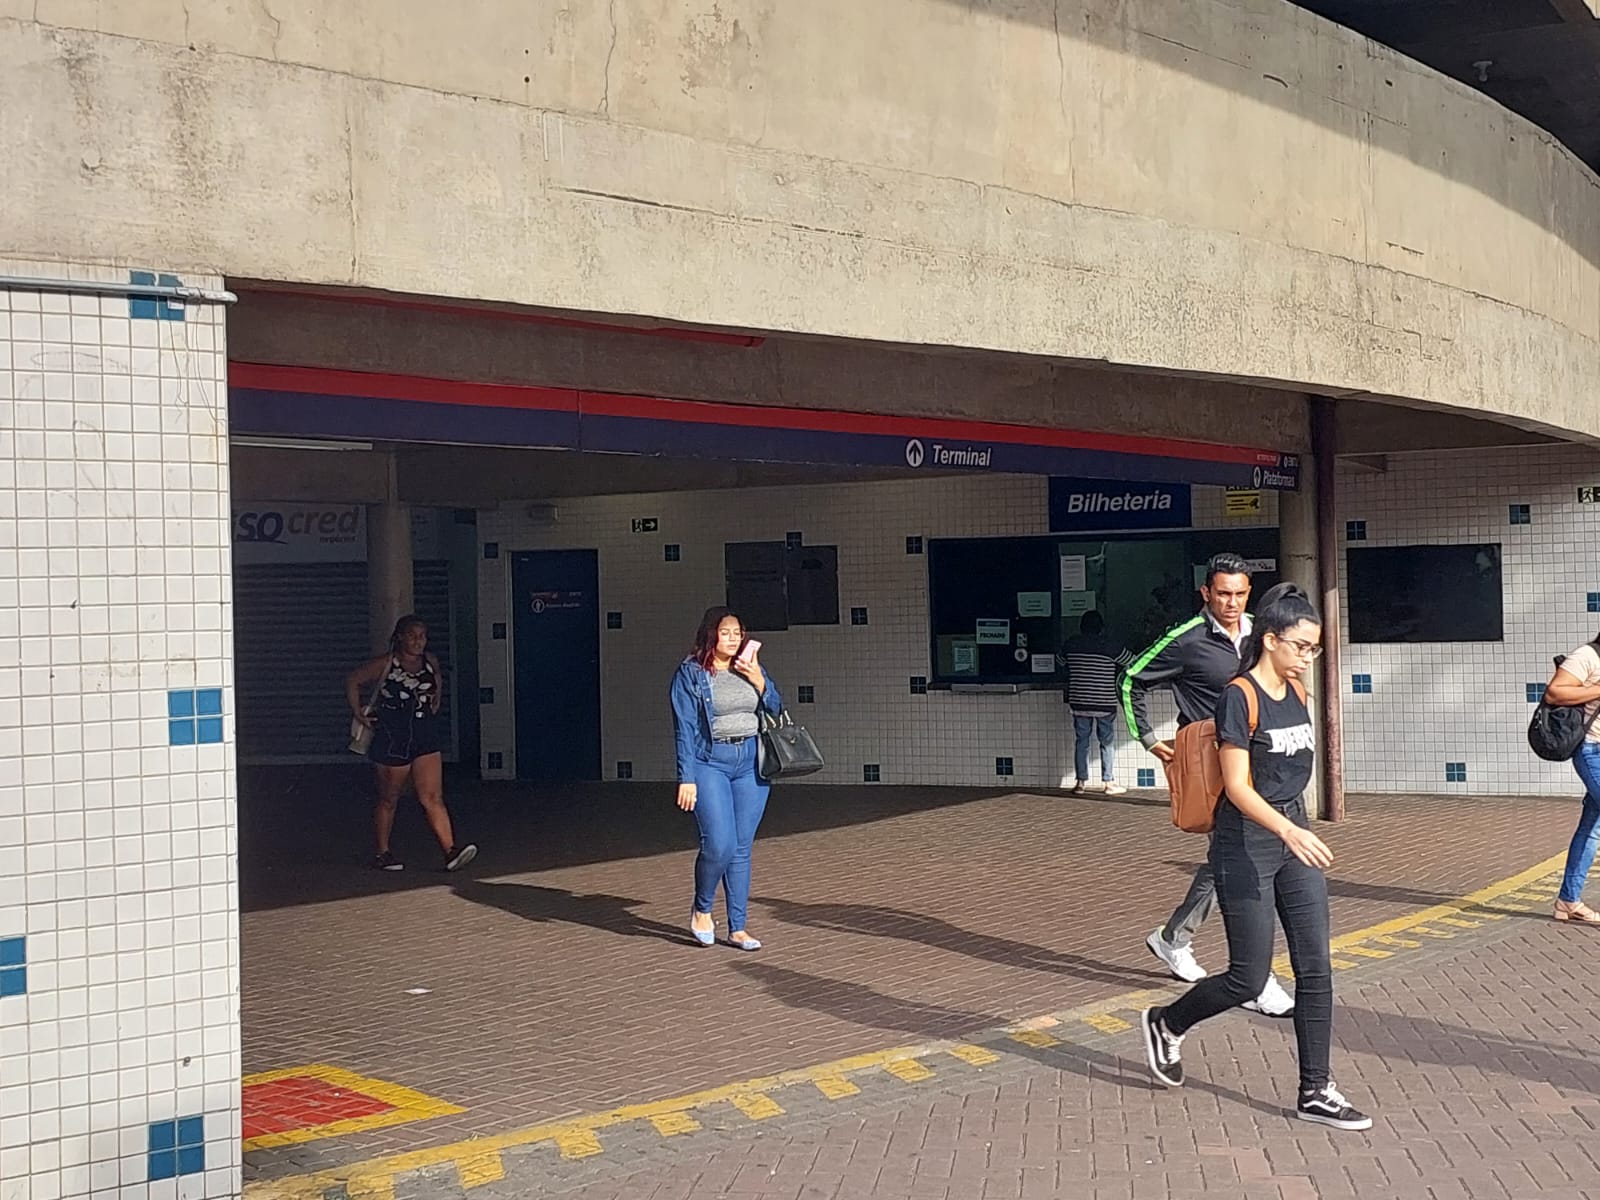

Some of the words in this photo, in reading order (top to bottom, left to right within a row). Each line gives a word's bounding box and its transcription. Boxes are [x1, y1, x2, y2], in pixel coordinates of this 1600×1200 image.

[933, 444, 992, 467] Terminal
[1263, 470, 1295, 488] Plataformas
[1067, 490, 1172, 513] Bilheteria
[287, 505, 361, 534] cred
[979, 632, 1006, 640] FECHADO
